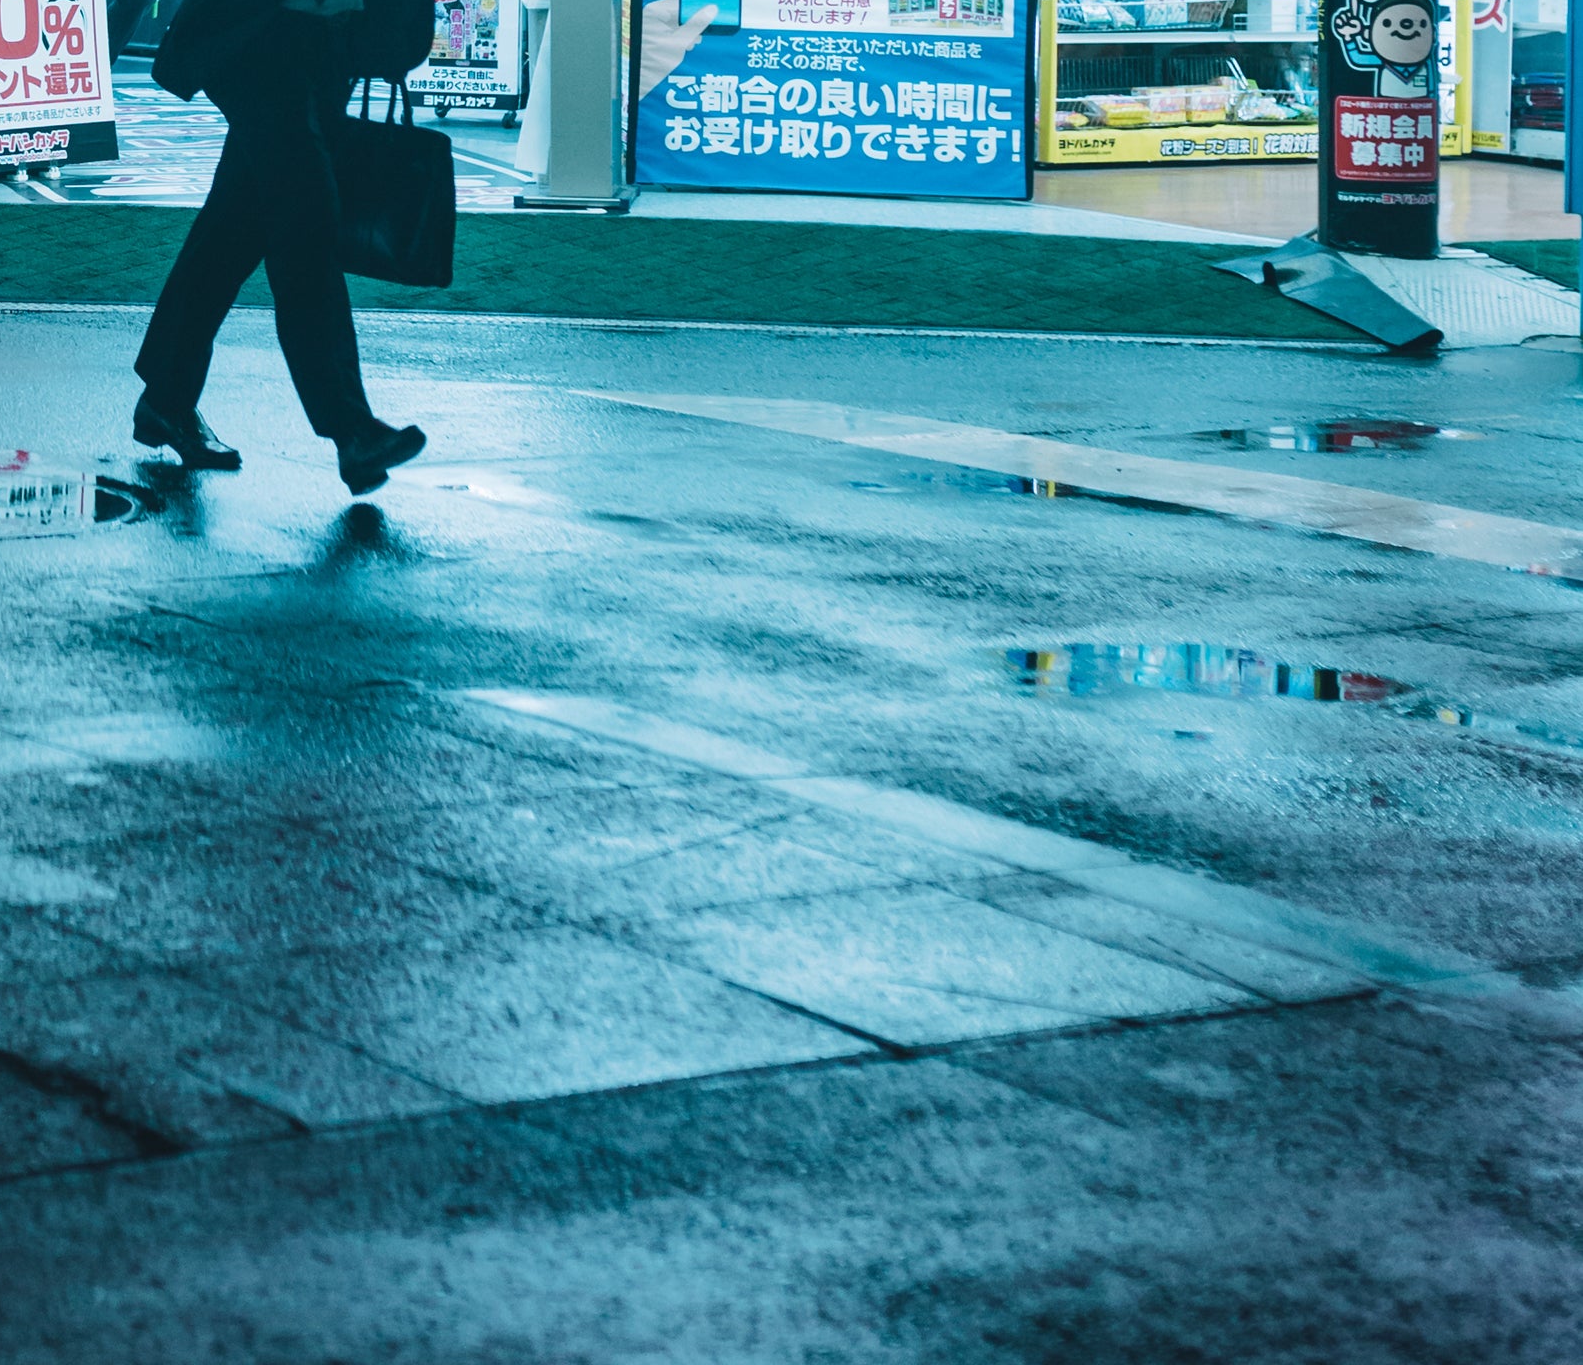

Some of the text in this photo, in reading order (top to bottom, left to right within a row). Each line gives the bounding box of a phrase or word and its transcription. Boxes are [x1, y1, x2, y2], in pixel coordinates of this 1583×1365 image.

[777, 8, 868, 26] いたします!
[746, 34, 983, 60] ネットでご注文いただいた商品を
[746, 52, 868, 73] お近くのお店で、
[431, 68, 495, 81] どうぞご自由に
[409, 78, 513, 94] お持ち帰りくださいませ。
[422, 94, 498, 109] ヨドバシカメラ
[664, 74, 1014, 123] ご都合の良い時間に
[1340, 111, 1434, 140] 新規会員
[664, 115, 1023, 165] お受け取りできます!
[1057, 138, 1117, 150] ヨドバシカメラ
[1159, 138, 1259, 157] 花粉シーズン到来!
[1350, 140, 1425, 167] 募集中
